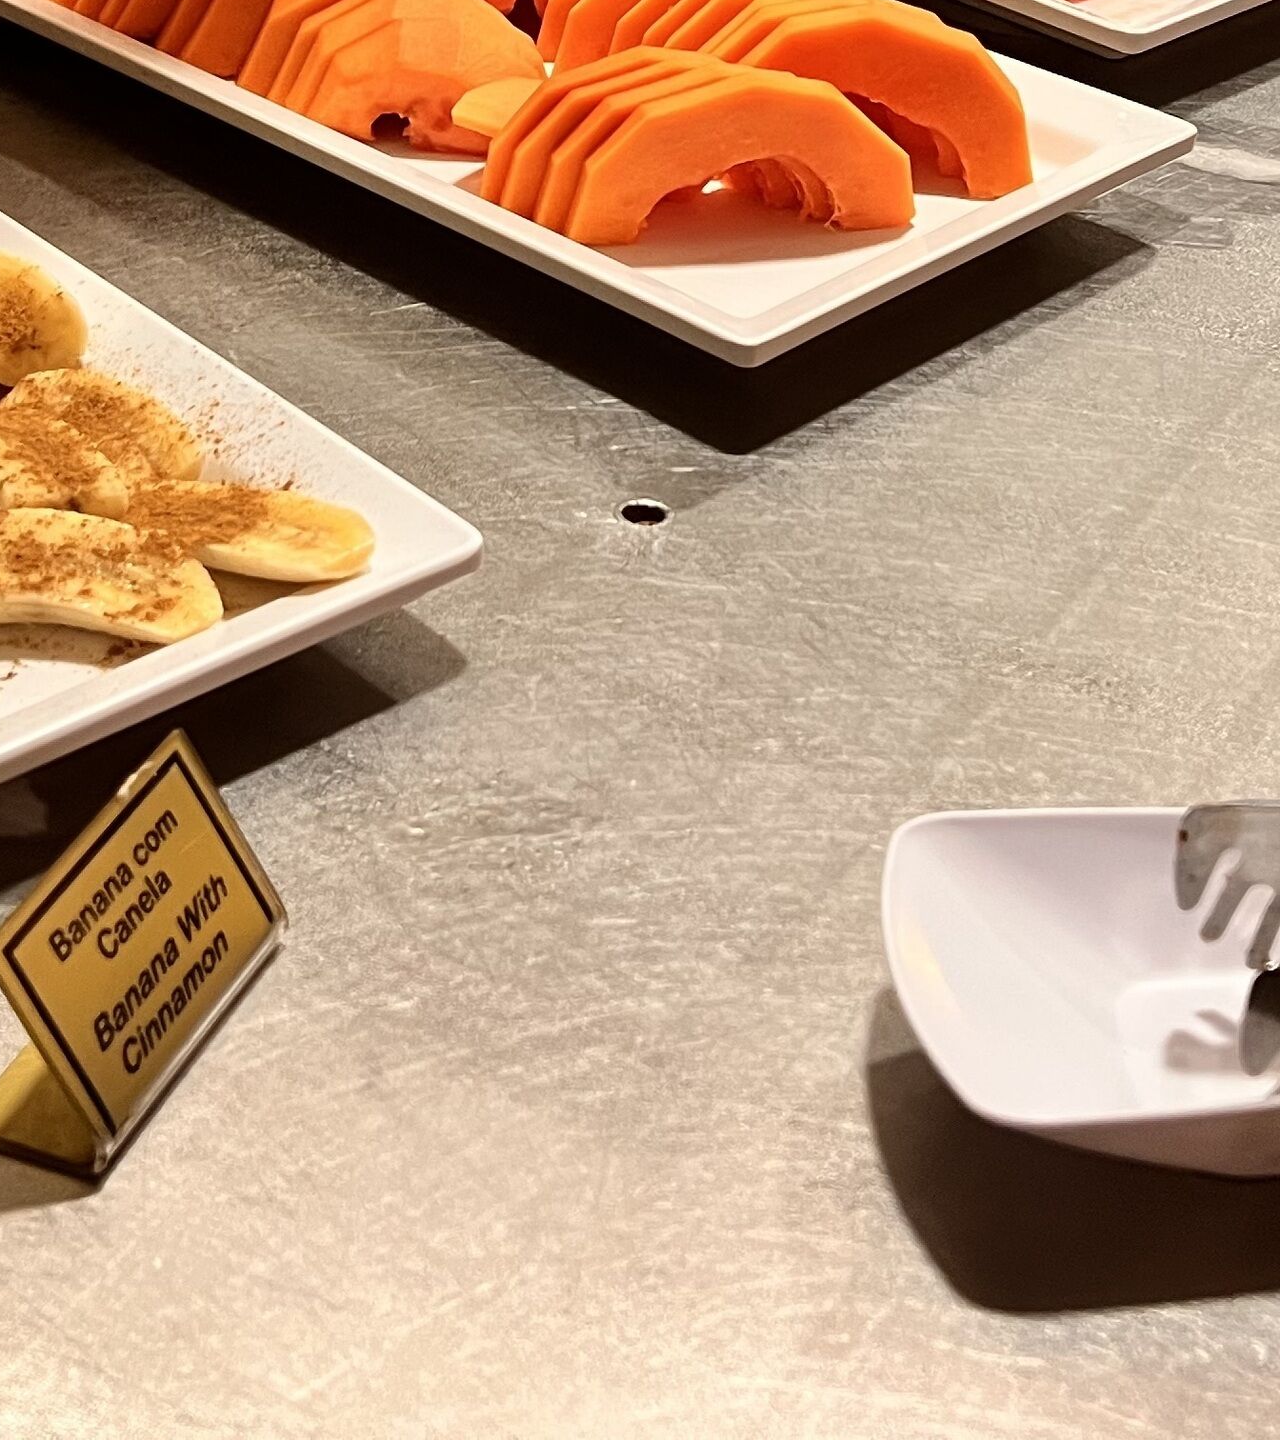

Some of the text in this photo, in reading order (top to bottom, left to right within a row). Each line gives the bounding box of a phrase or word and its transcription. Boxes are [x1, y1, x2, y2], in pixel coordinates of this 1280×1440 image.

[48, 810, 178, 962] Banana com
[97, 870, 172, 959] Canela
[94, 874, 228, 1052] Banana With
[122, 930, 229, 1074] Cinnamon
